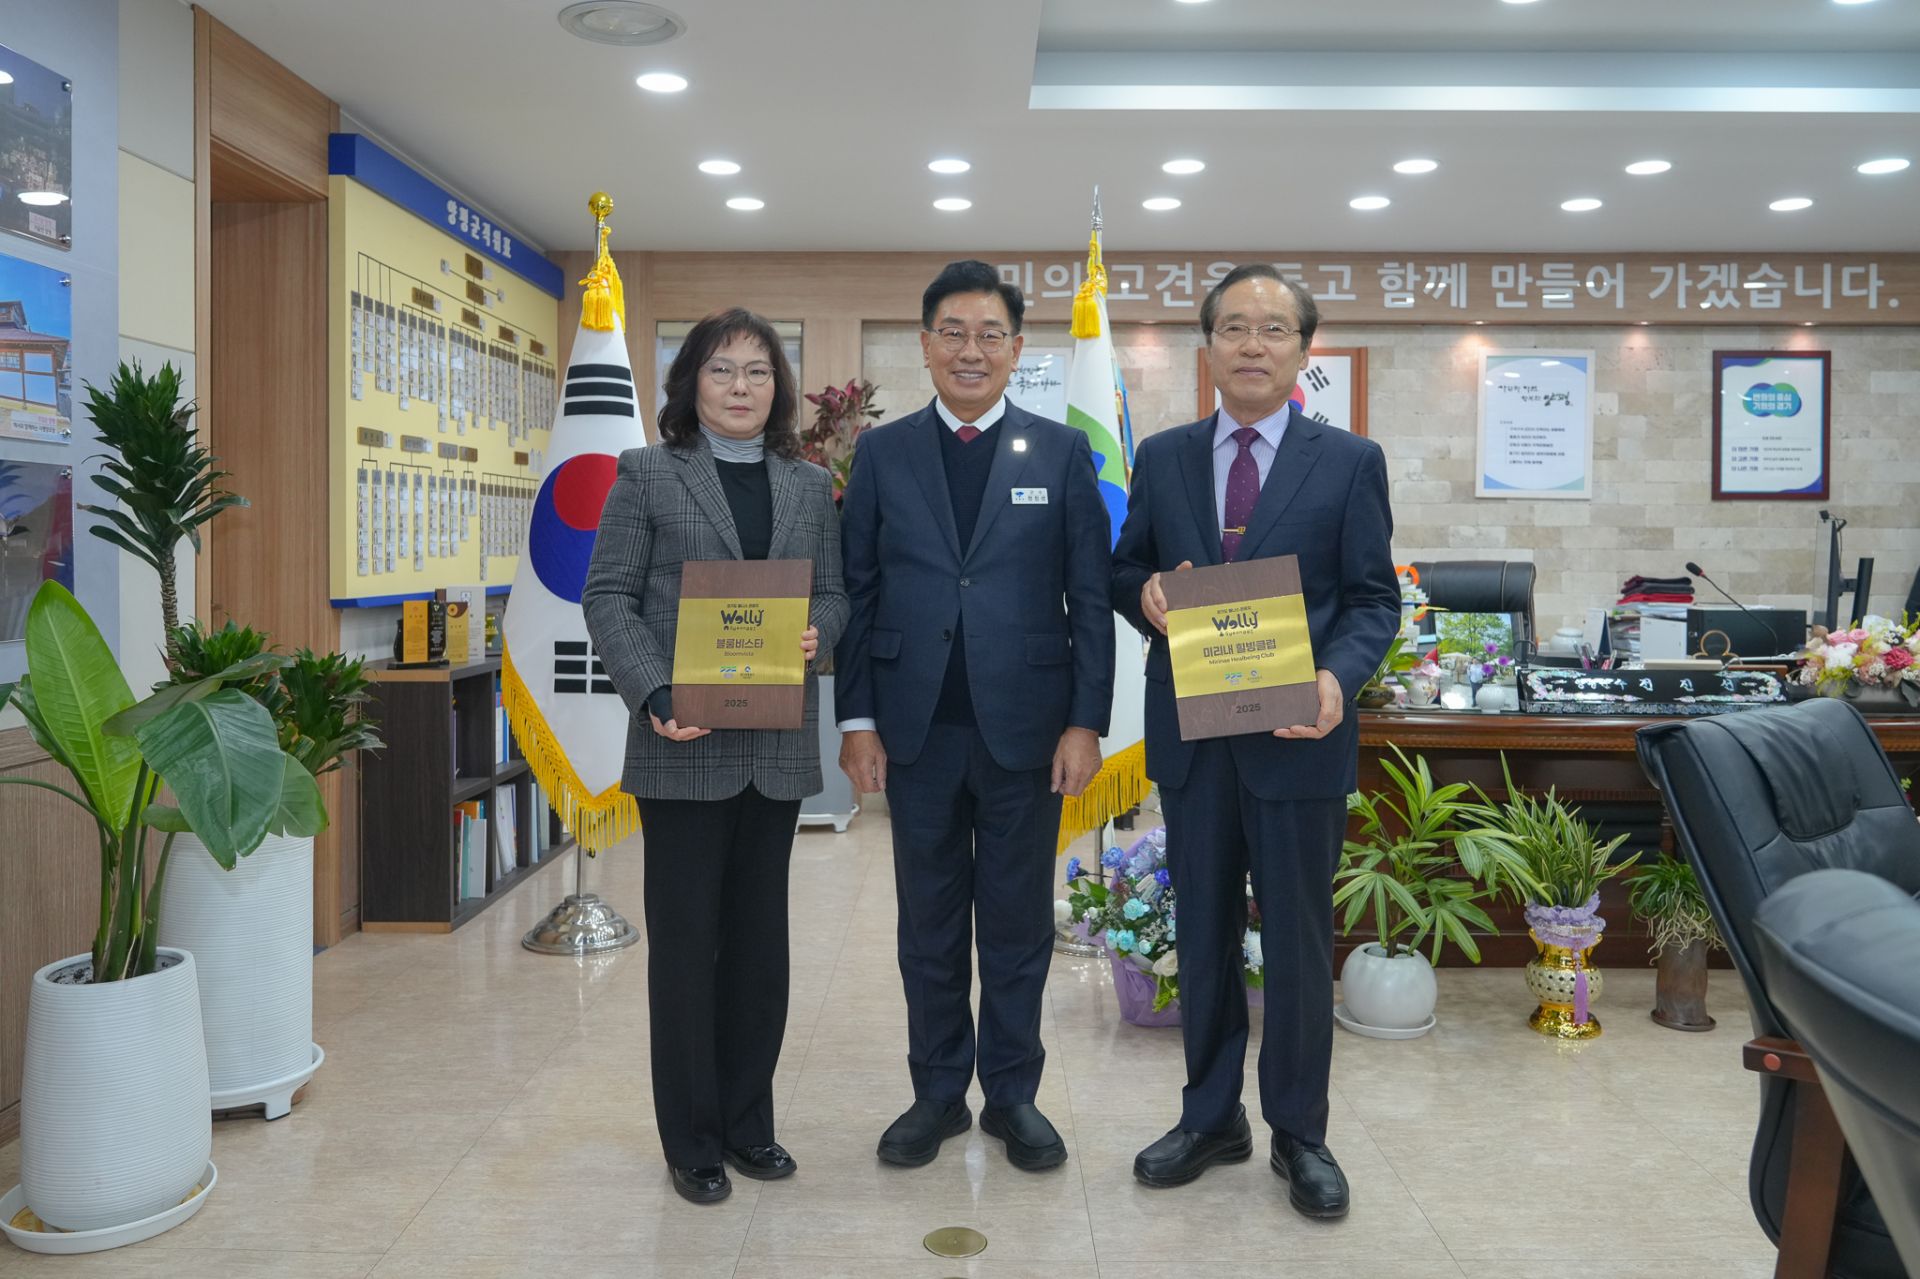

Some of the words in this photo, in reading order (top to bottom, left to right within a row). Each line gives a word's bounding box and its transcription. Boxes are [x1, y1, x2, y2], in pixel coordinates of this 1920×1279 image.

[1377, 261, 1467, 309] 함께
[1490, 262, 1624, 309] 만들어
[1648, 262, 1900, 309] 가겠습니다.
[1203, 644, 1234, 658] 미리내
[1236, 638, 1277, 654] 힐빙클럽
[724, 699, 749, 708] 2025
[1235, 703, 1262, 714] 2025
